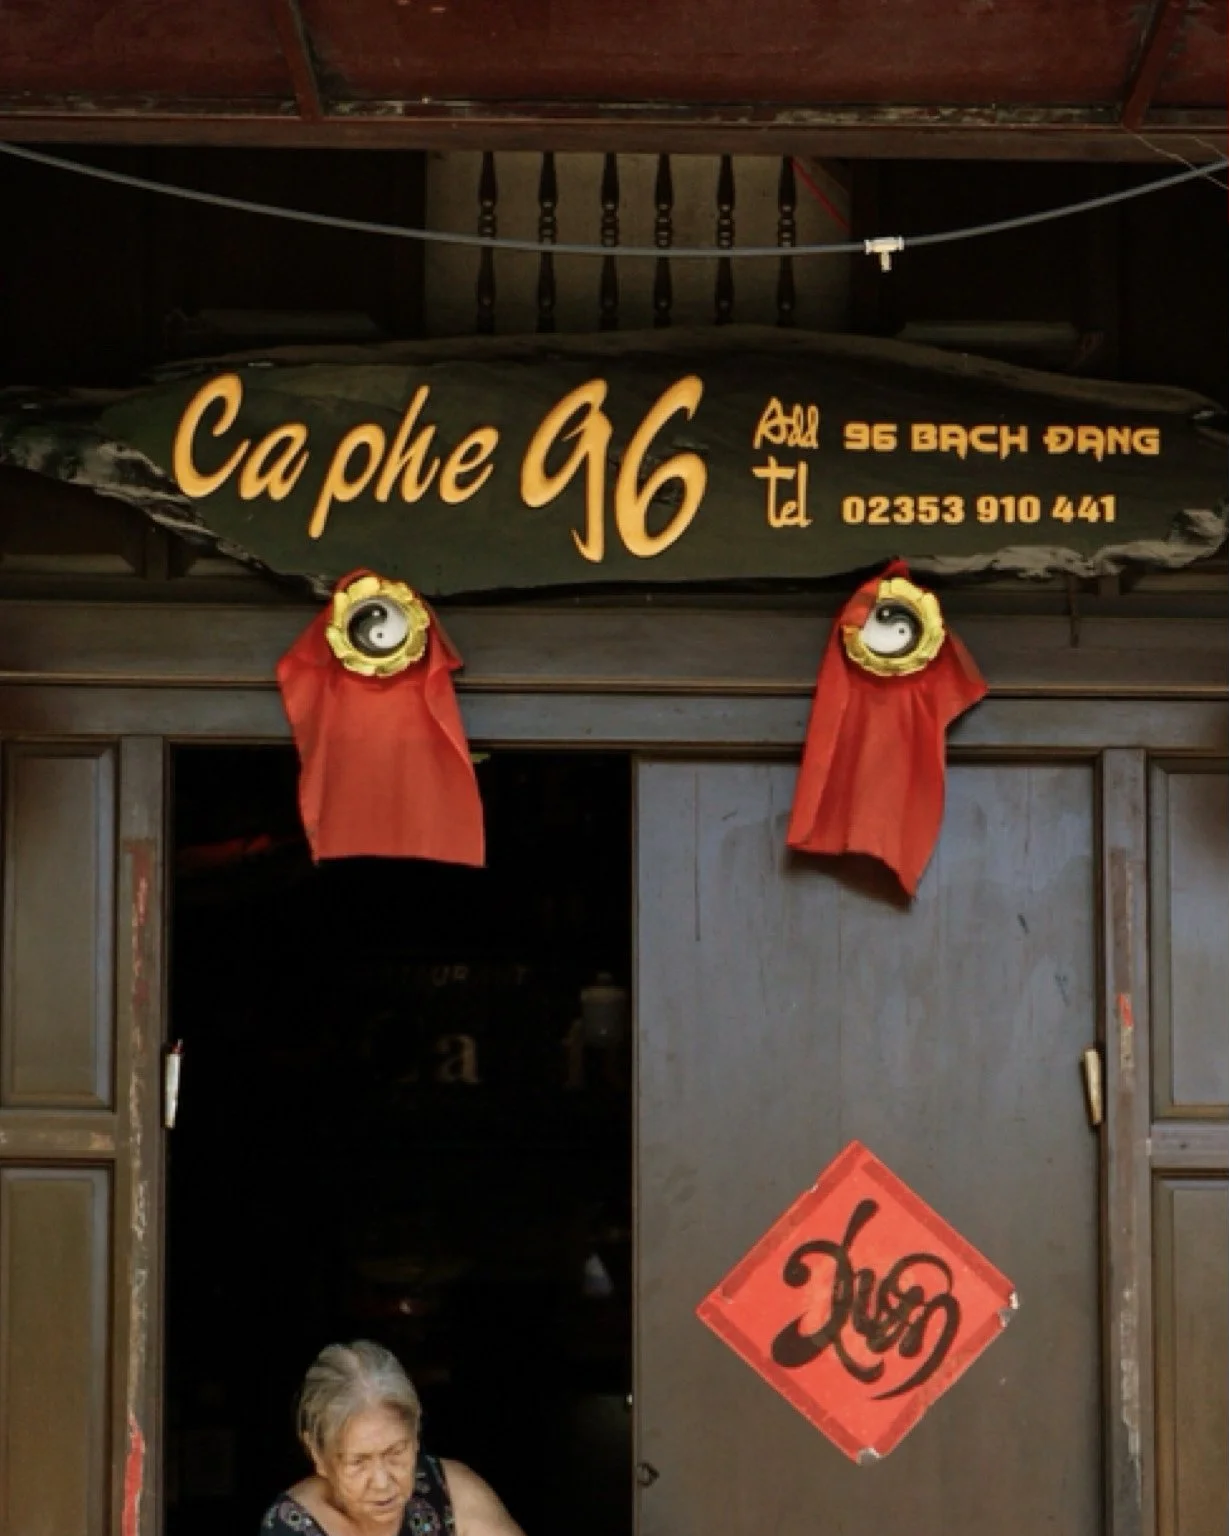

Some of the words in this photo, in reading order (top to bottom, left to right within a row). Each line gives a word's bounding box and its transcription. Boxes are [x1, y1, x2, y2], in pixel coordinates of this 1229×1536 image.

[520, 374, 708, 563] 96
[842, 422, 898, 453] 96
[751, 455, 812, 529] tel
[841, 495, 966, 525] 02353
[975, 495, 1041, 525] 910
[1051, 495, 1117, 525] 441
